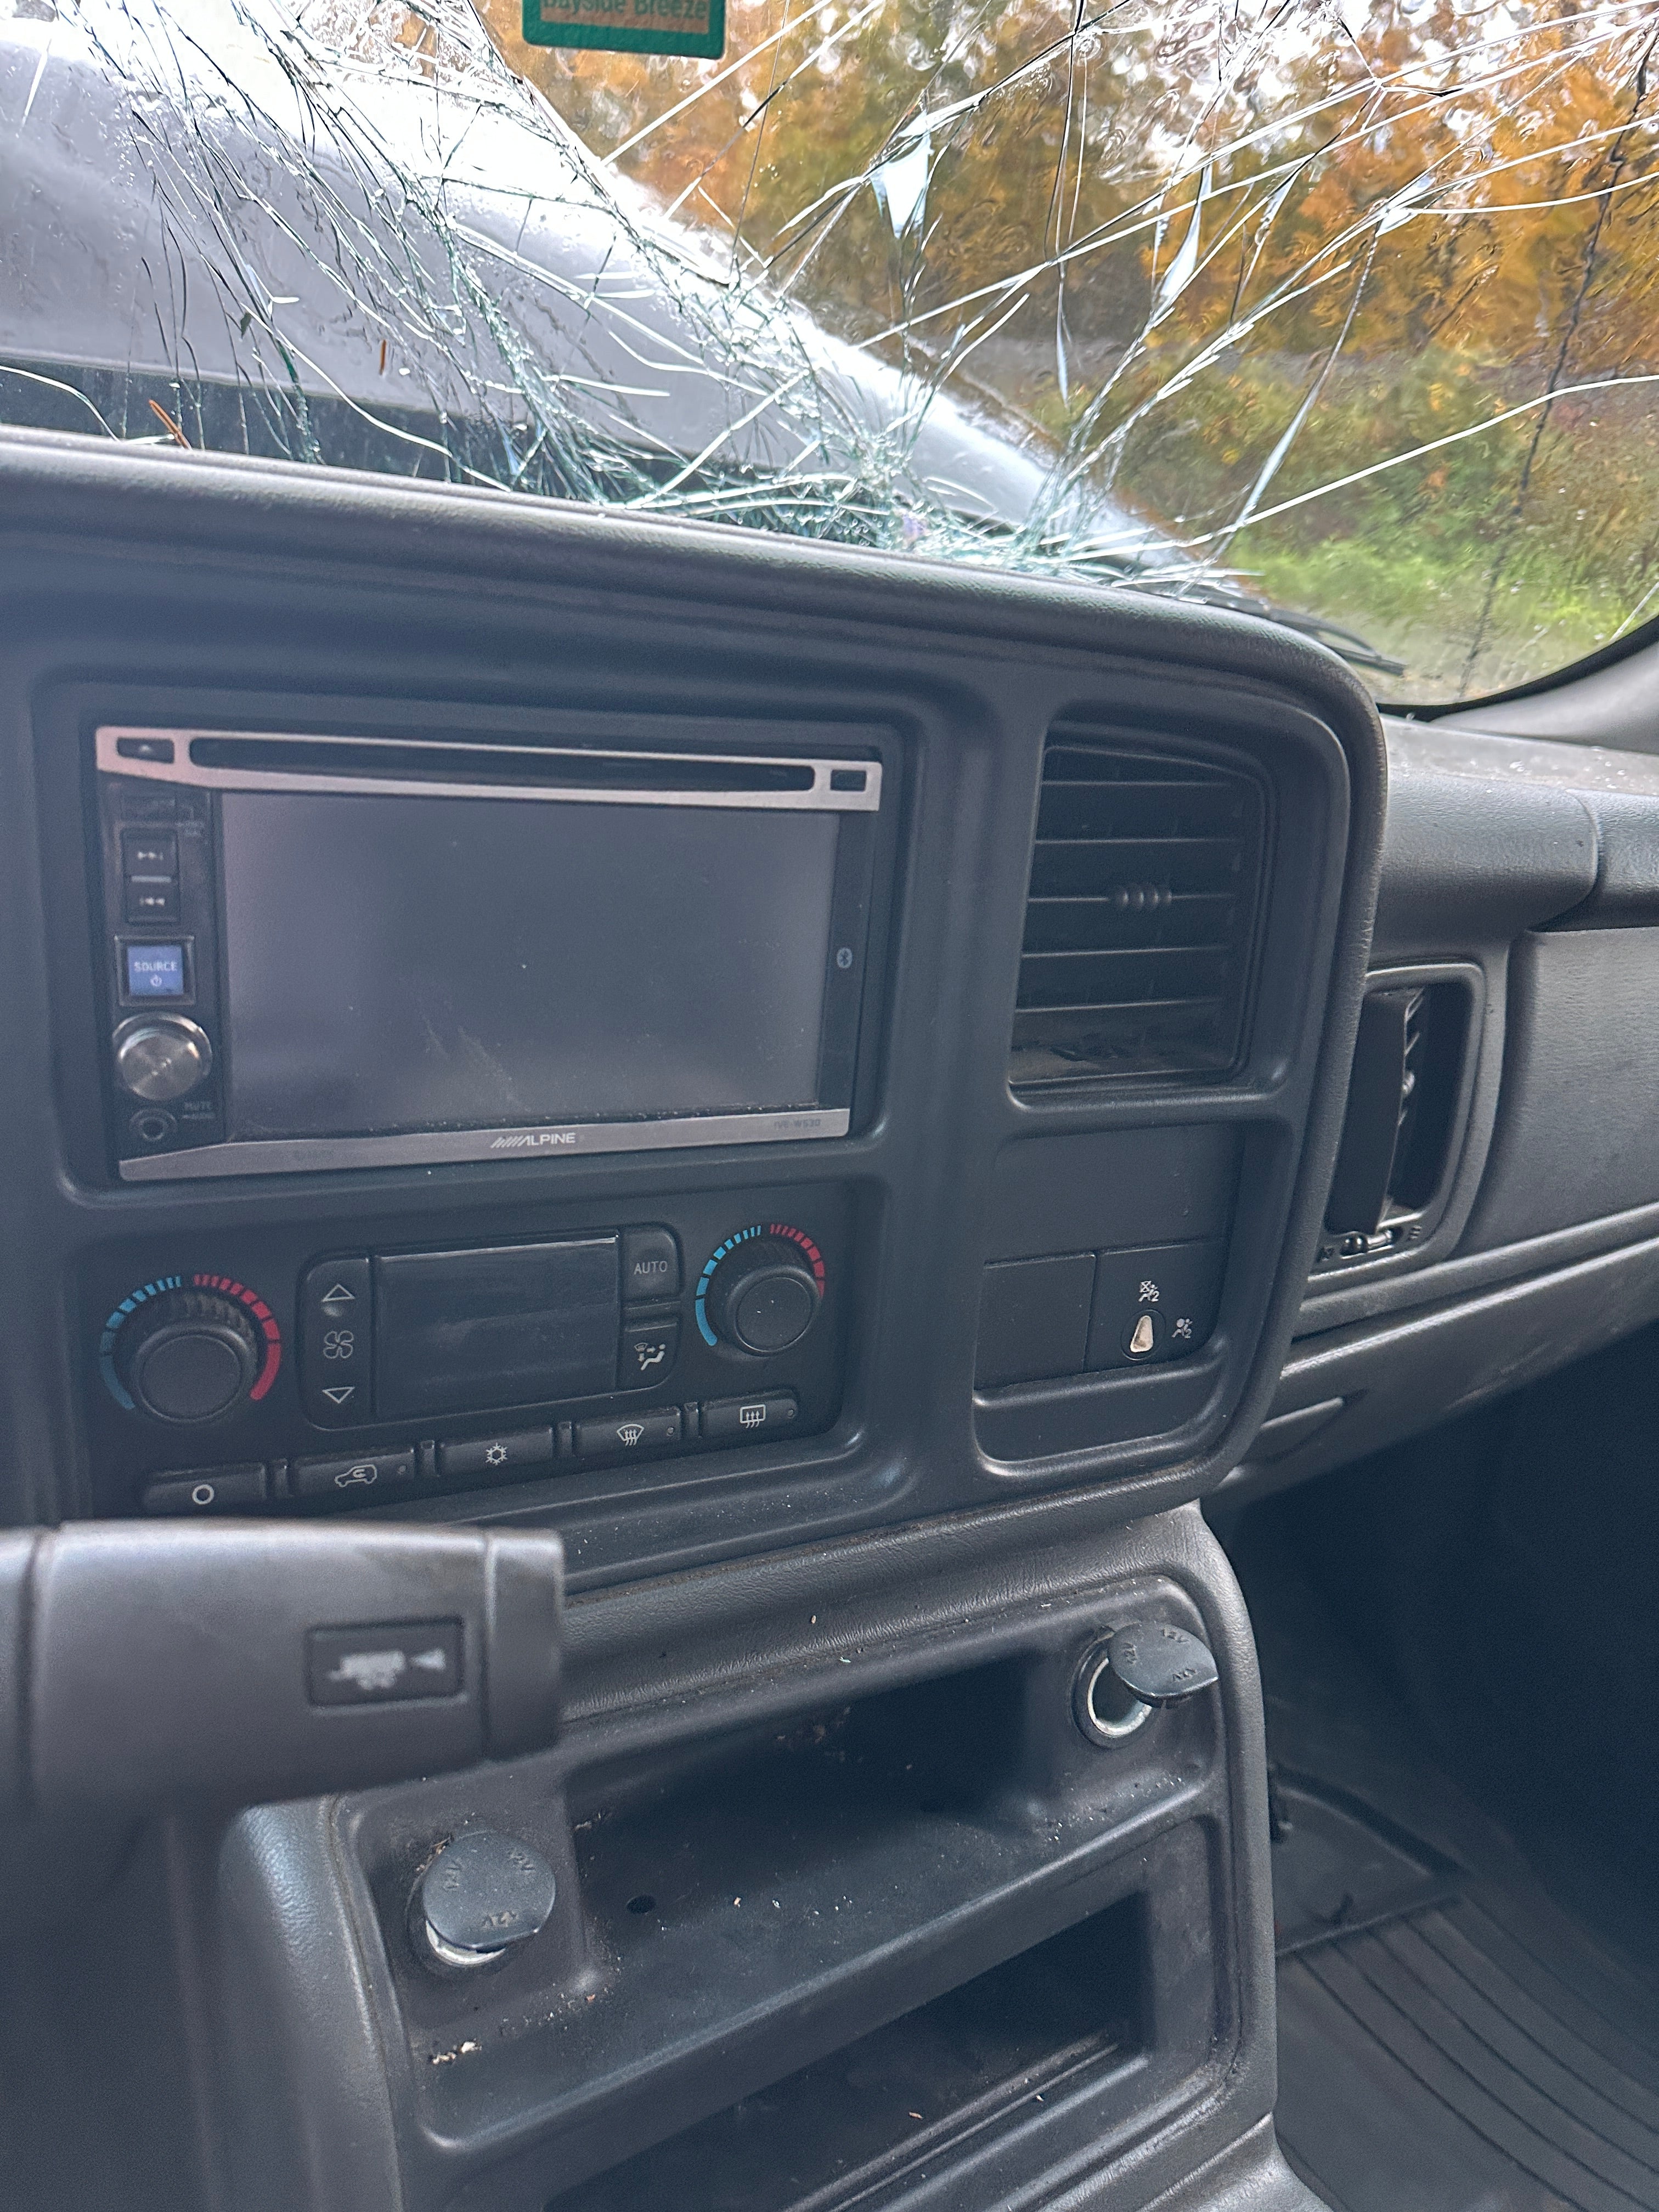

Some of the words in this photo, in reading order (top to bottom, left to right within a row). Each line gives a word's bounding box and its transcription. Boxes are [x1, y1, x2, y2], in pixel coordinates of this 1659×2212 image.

[634, 0, 707, 19] Breeze
[133, 961, 178, 972] SOURCE
[516, 1131, 577, 1147] ALPINE
[634, 1260, 668, 1274] AUTO
